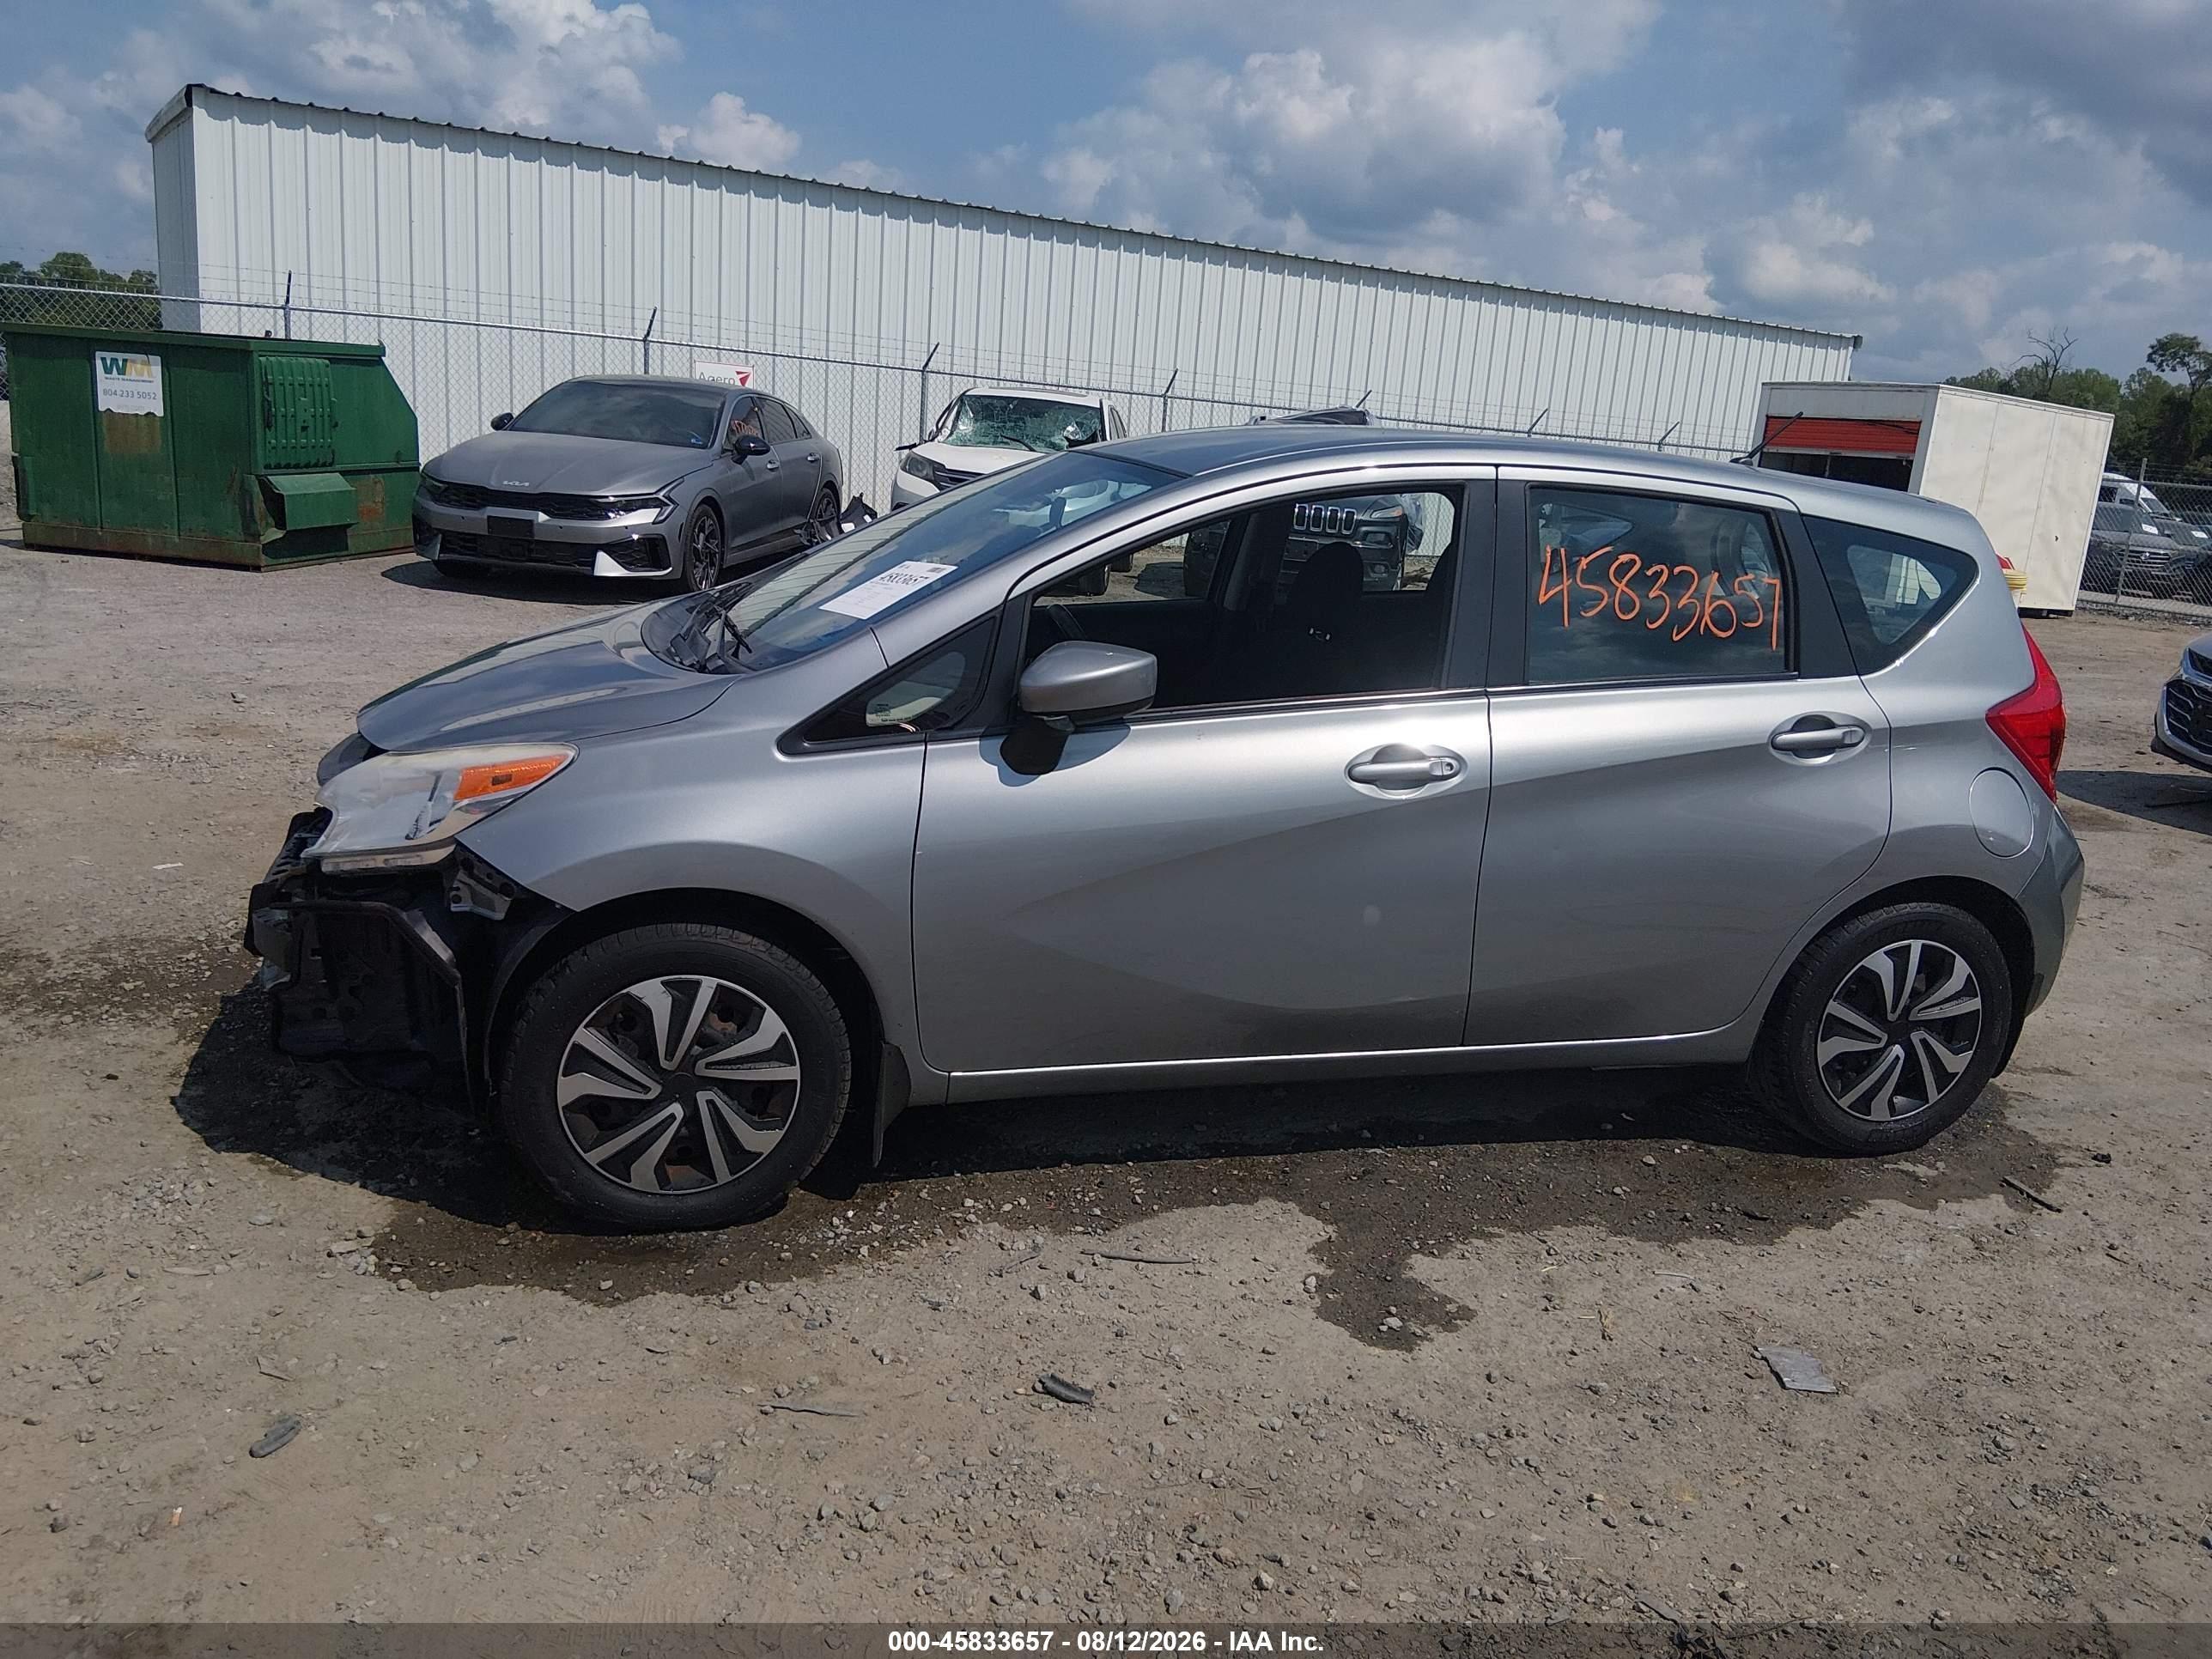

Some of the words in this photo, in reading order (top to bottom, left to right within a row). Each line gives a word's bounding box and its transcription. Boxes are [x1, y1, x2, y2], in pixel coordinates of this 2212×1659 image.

[100, 356, 152, 379] WM
[103, 388, 118, 397] 804
[119, 390, 135, 398] 233
[137, 391, 157, 400] 5052
[1538, 544, 1781, 651] 45833657
